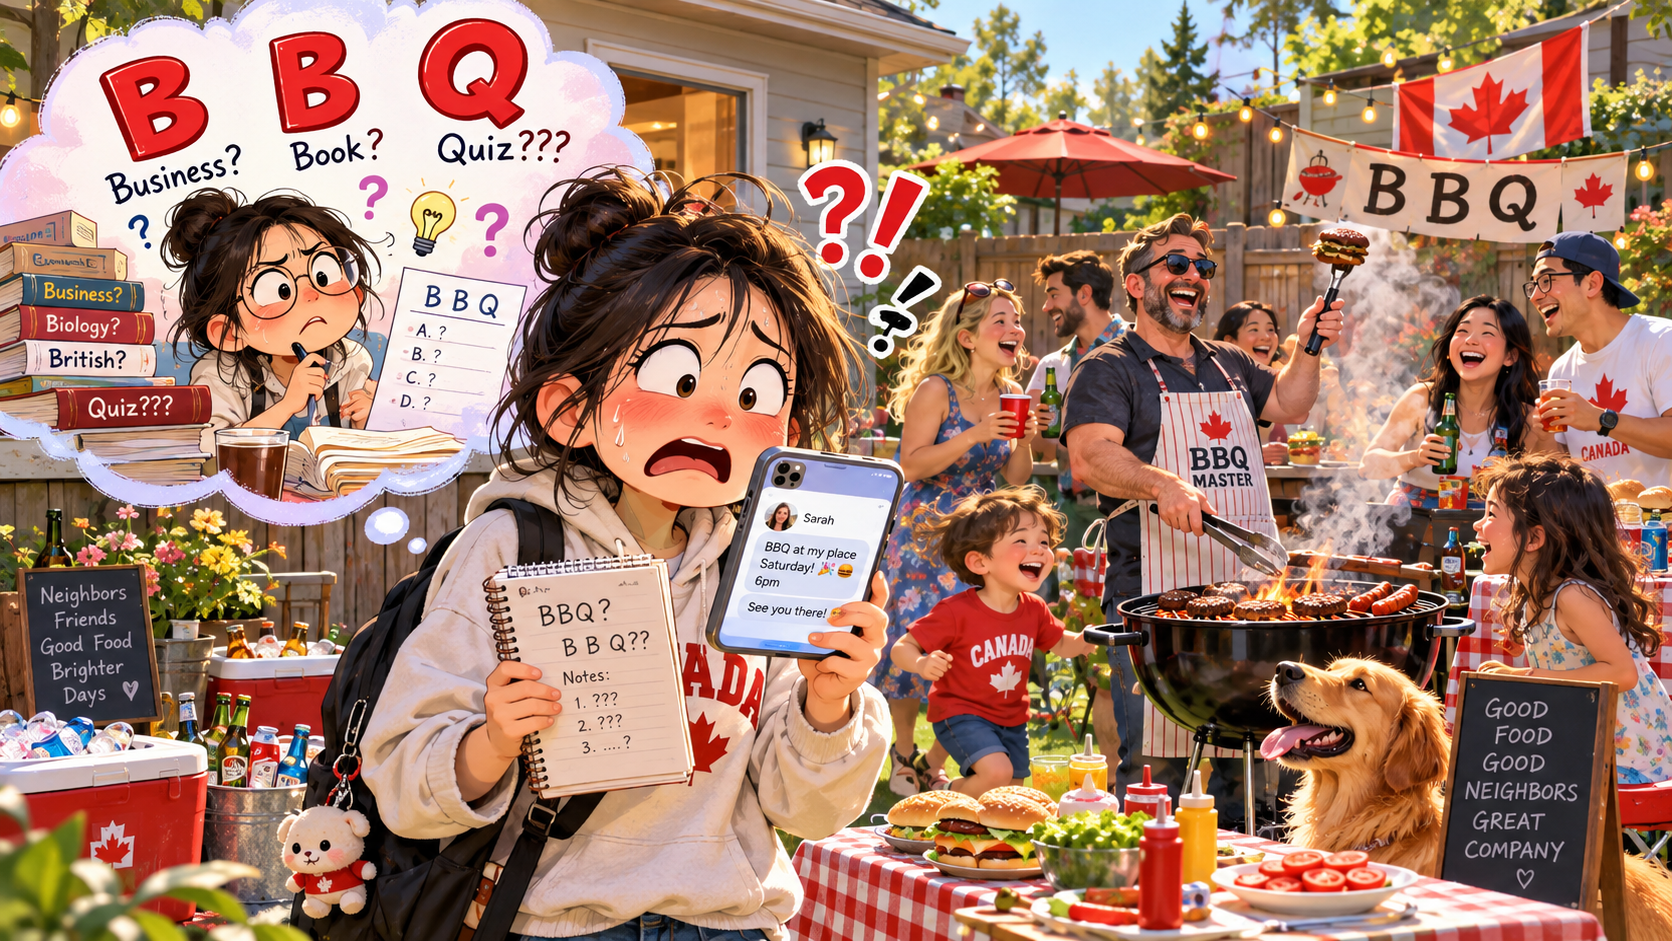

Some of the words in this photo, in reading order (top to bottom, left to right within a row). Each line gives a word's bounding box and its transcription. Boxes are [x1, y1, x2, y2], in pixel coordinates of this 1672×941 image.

[99, 55, 209, 162] B
[269, 31, 360, 134] B
[418, 18, 528, 129] Q
[290, 128, 383, 171] Book?
[437, 129, 571, 166] Quiz???
[105, 144, 242, 205] Business?
[44, 282, 123, 303] Business?
[46, 314, 120, 339] Biology?
[416, 323, 431, 338] A.
[439, 326, 447, 340] ?
[49, 348, 127, 369] British?
[411, 347, 426, 361] B.
[434, 349, 442, 363] ?
[406, 371, 420, 385] C.
[428, 373, 436, 387] ?
[88, 395, 174, 421] Quiz???
[400, 394, 415, 409] D.
[423, 396, 431, 410] ?
[1189, 446, 1249, 471] BBQ
[1581, 440, 1630, 462] CANADA
[1192, 473, 1253, 488] MASTER
[803, 513, 835, 526] Sarah
[764, 541, 791, 554] BBQ
[793, 545, 805, 555] at
[807, 549, 825, 560] my
[826, 547, 857, 560] place
[760, 558, 815, 574] Saturday!
[754, 575, 780, 589] 6pm
[41, 584, 127, 608] Neighbors
[54, 608, 117, 629] Friends
[538, 598, 610, 626] BBQ?
[747, 601, 768, 614] See
[771, 606, 792, 621] you
[794, 606, 827, 619] there!
[40, 635, 83, 656] Good
[94, 631, 132, 651] Food
[970, 633, 1034, 668] CANADA
[51, 660, 124, 683] Brighter
[563, 670, 610, 686] Notes:
[63, 686, 106, 708] Days
[681, 642, 765, 731] ADA
[575, 697, 587, 709] 1.
[592, 691, 618, 708] ???
[1485, 697, 1549, 719] GOOD
[578, 720, 592, 732] 2.
[597, 714, 623, 730] ???
[1495, 725, 1553, 745] FOOD
[582, 741, 596, 754] 3.
[1482, 752, 1545, 773] GOOD
[1465, 781, 1578, 802] NEIGHBORS
[1473, 810, 1546, 833] GREAT
[1465, 840, 1565, 863] COMPANY
